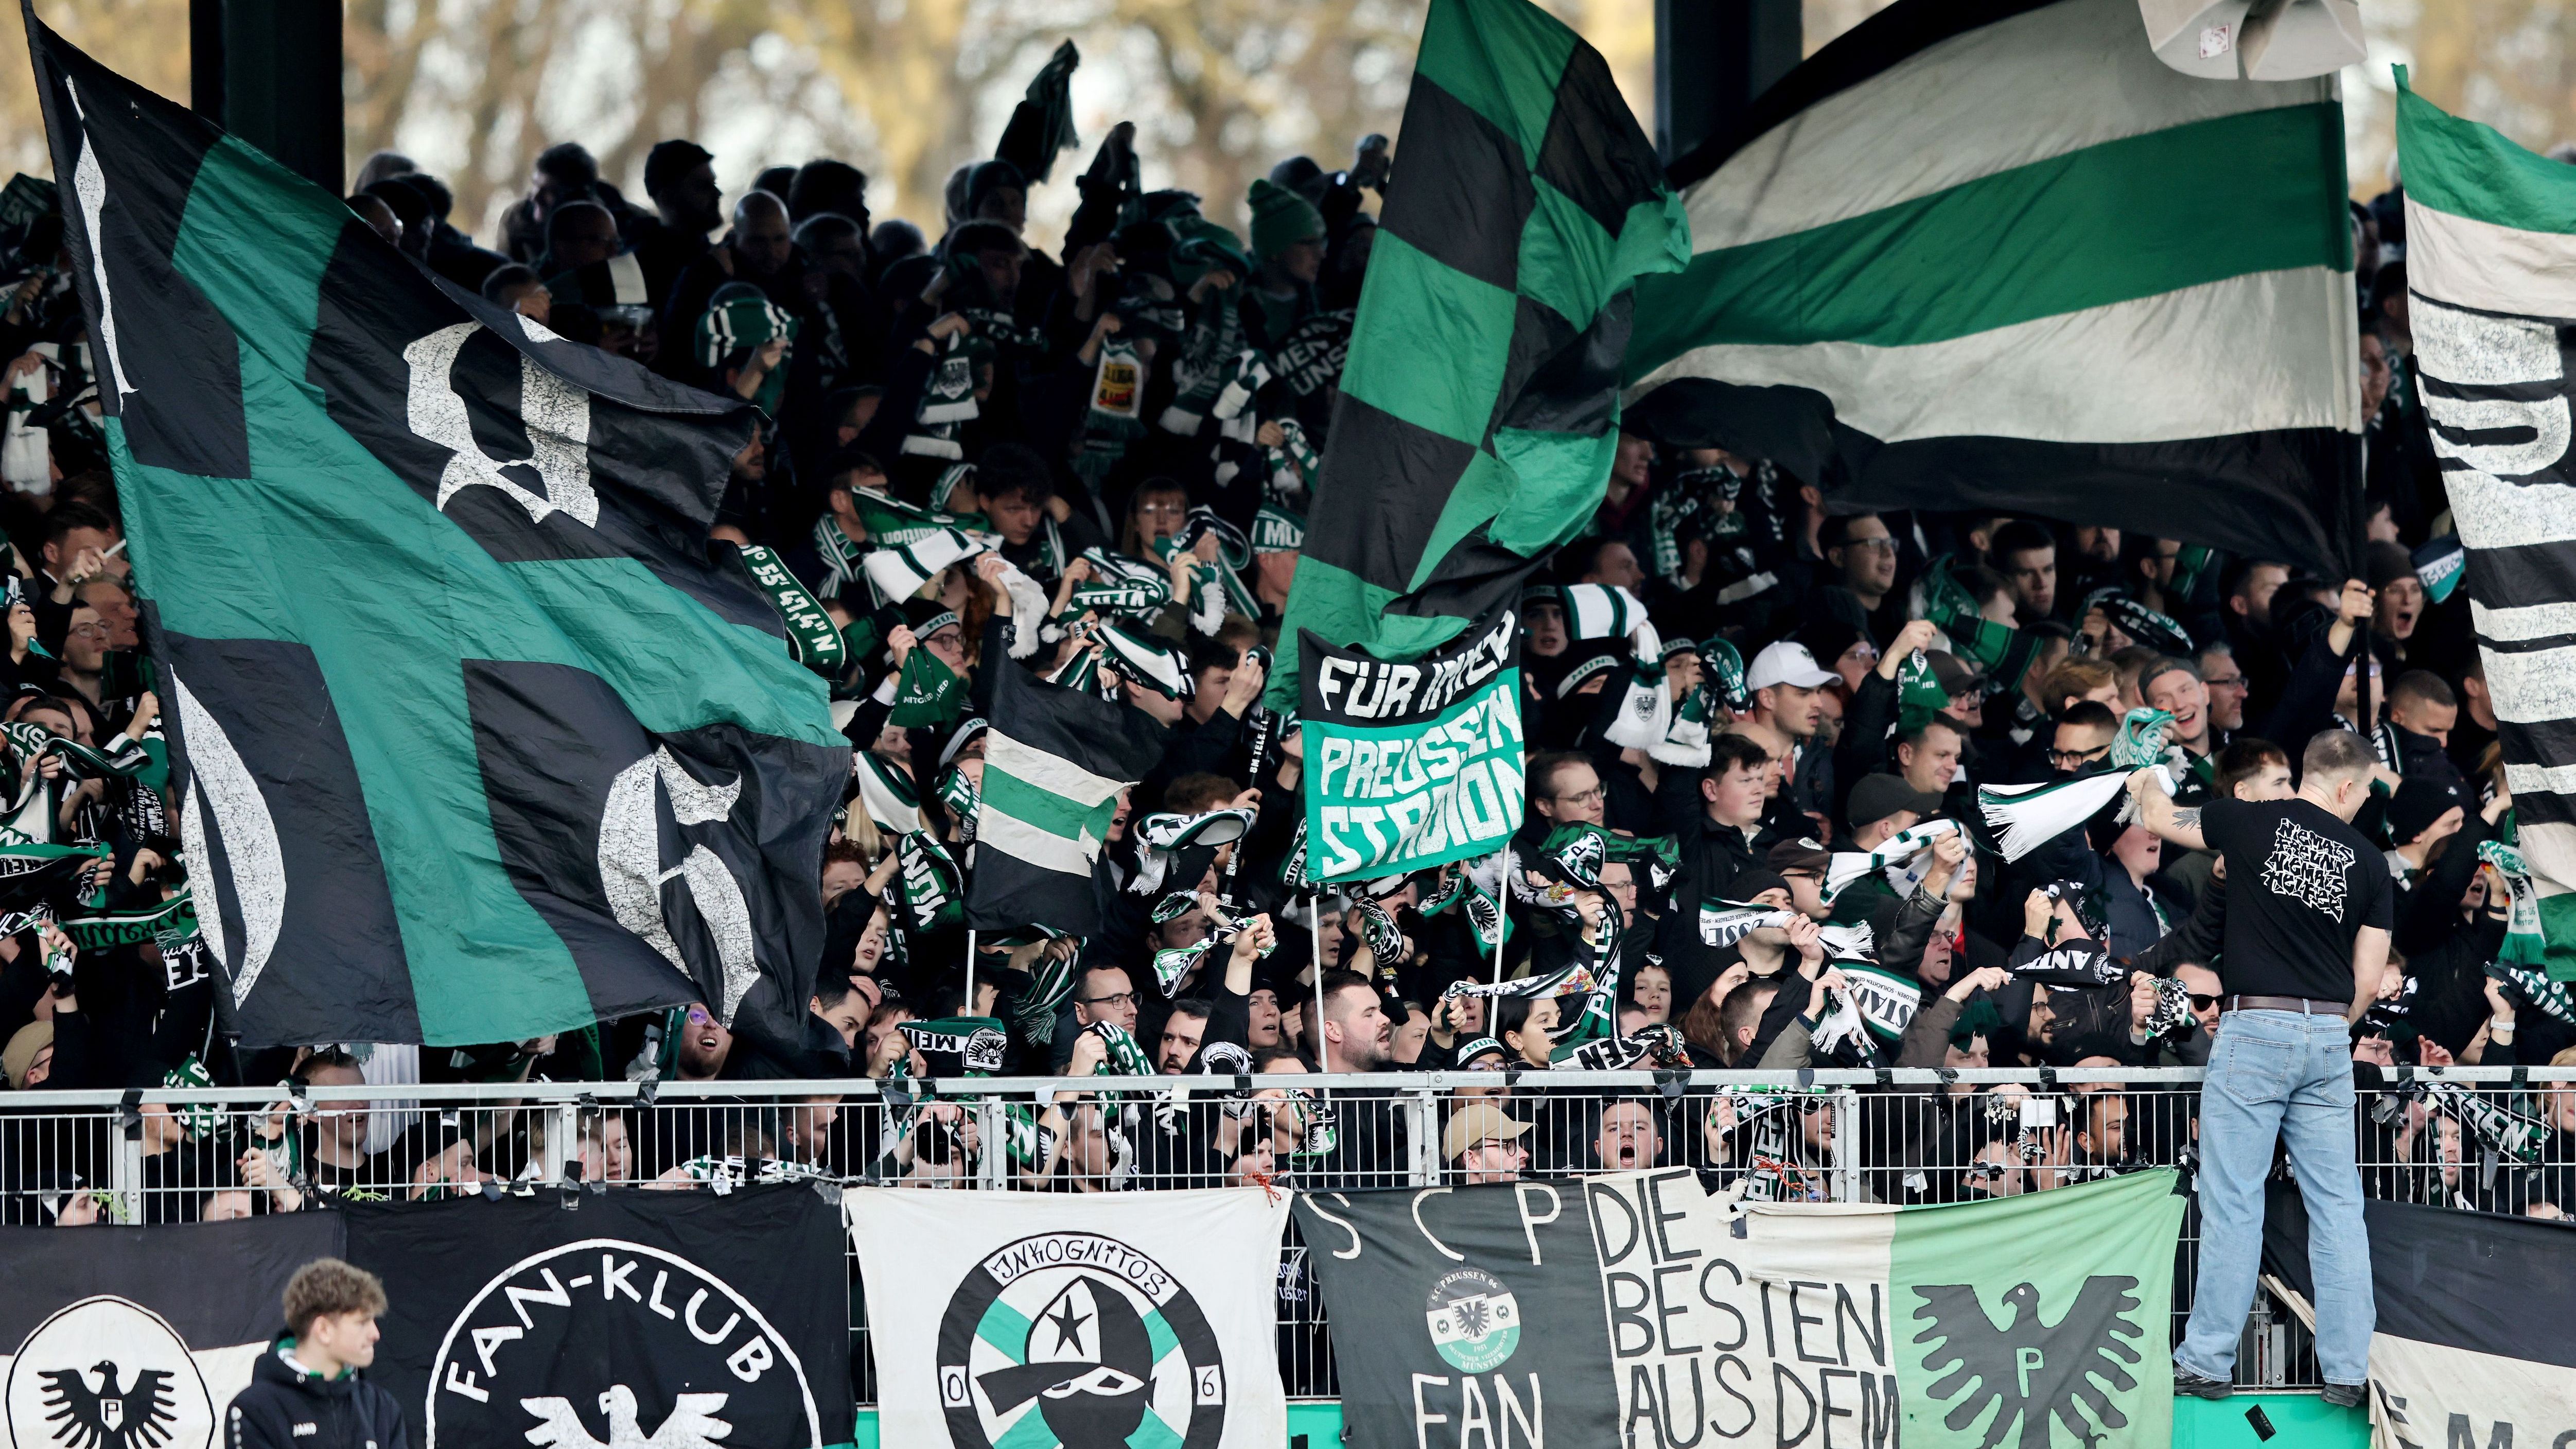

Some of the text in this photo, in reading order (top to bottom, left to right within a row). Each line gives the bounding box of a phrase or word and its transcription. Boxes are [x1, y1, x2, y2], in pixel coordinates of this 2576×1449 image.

[811, 634, 837, 652] N
[1318, 655, 1422, 719] FÜR
[597, 743, 764, 1028] 6
[1412, 1187, 1465, 1262] C
[1514, 1182, 1562, 1266] P
[1587, 1168, 1703, 1268] DIE
[1440, 1270, 1487, 1288] PREUSSEN
[1606, 1258, 1886, 1367] BESTEN
[445, 1253, 774, 1404] FAN-KLUB
[104, 1400, 119, 1421] P
[1202, 1373, 1215, 1396] 6
[1412, 1372, 1544, 1449] FAN
[1625, 1354, 1900, 1449] AUS DEM
[2016, 1347, 2044, 1398] P
